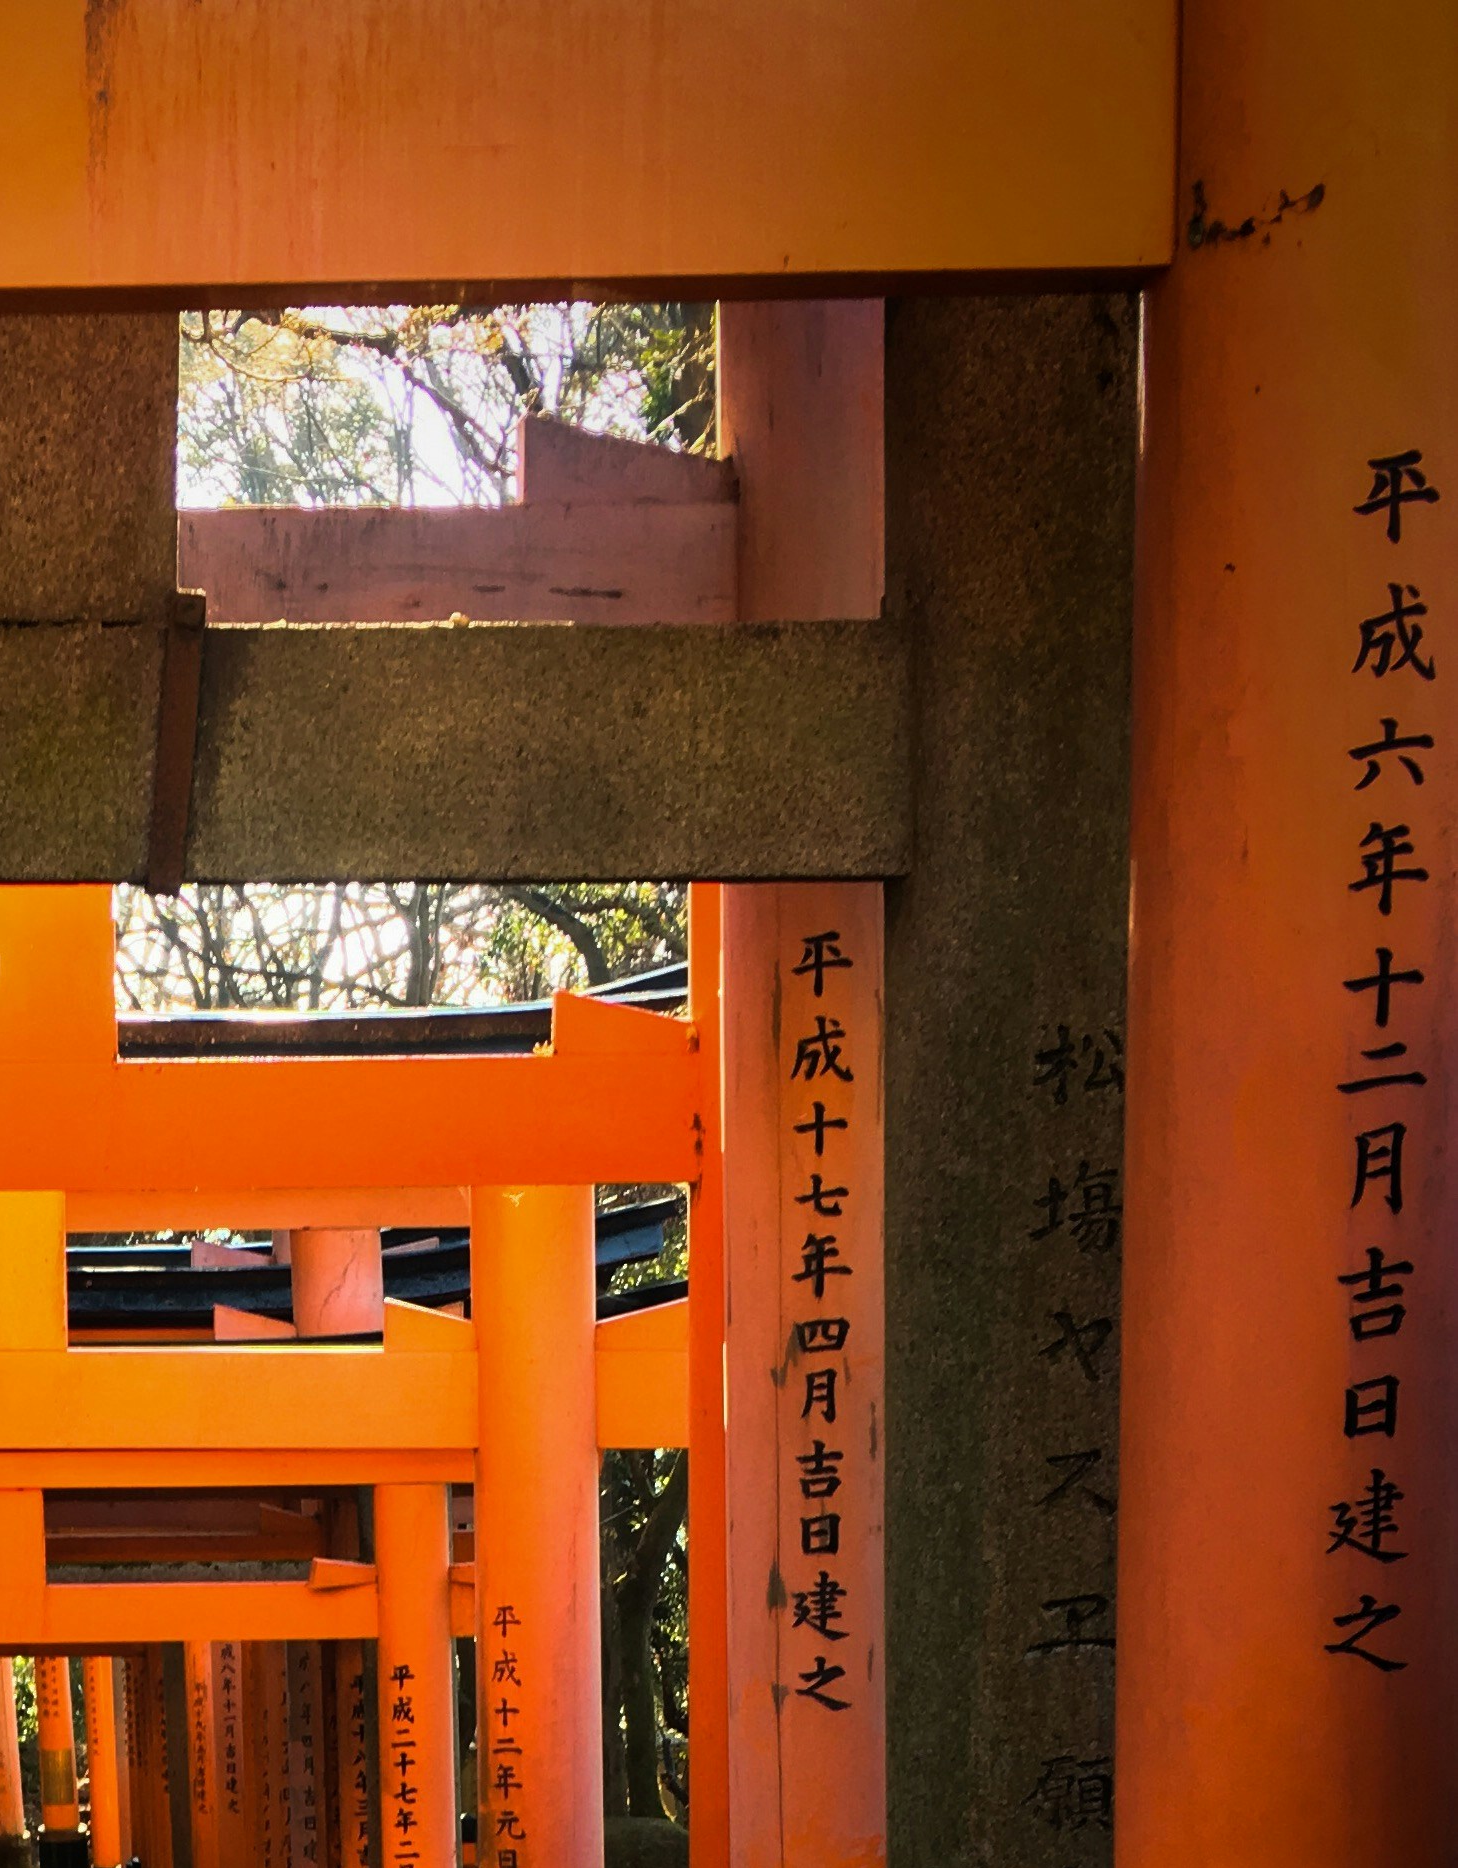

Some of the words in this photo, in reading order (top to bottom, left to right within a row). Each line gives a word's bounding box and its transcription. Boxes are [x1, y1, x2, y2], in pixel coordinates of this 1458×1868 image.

[789, 930, 855, 1713] 平成十七年四月吉日建之
[1324, 449, 1440, 1673] 平成六年十二月吉日建之
